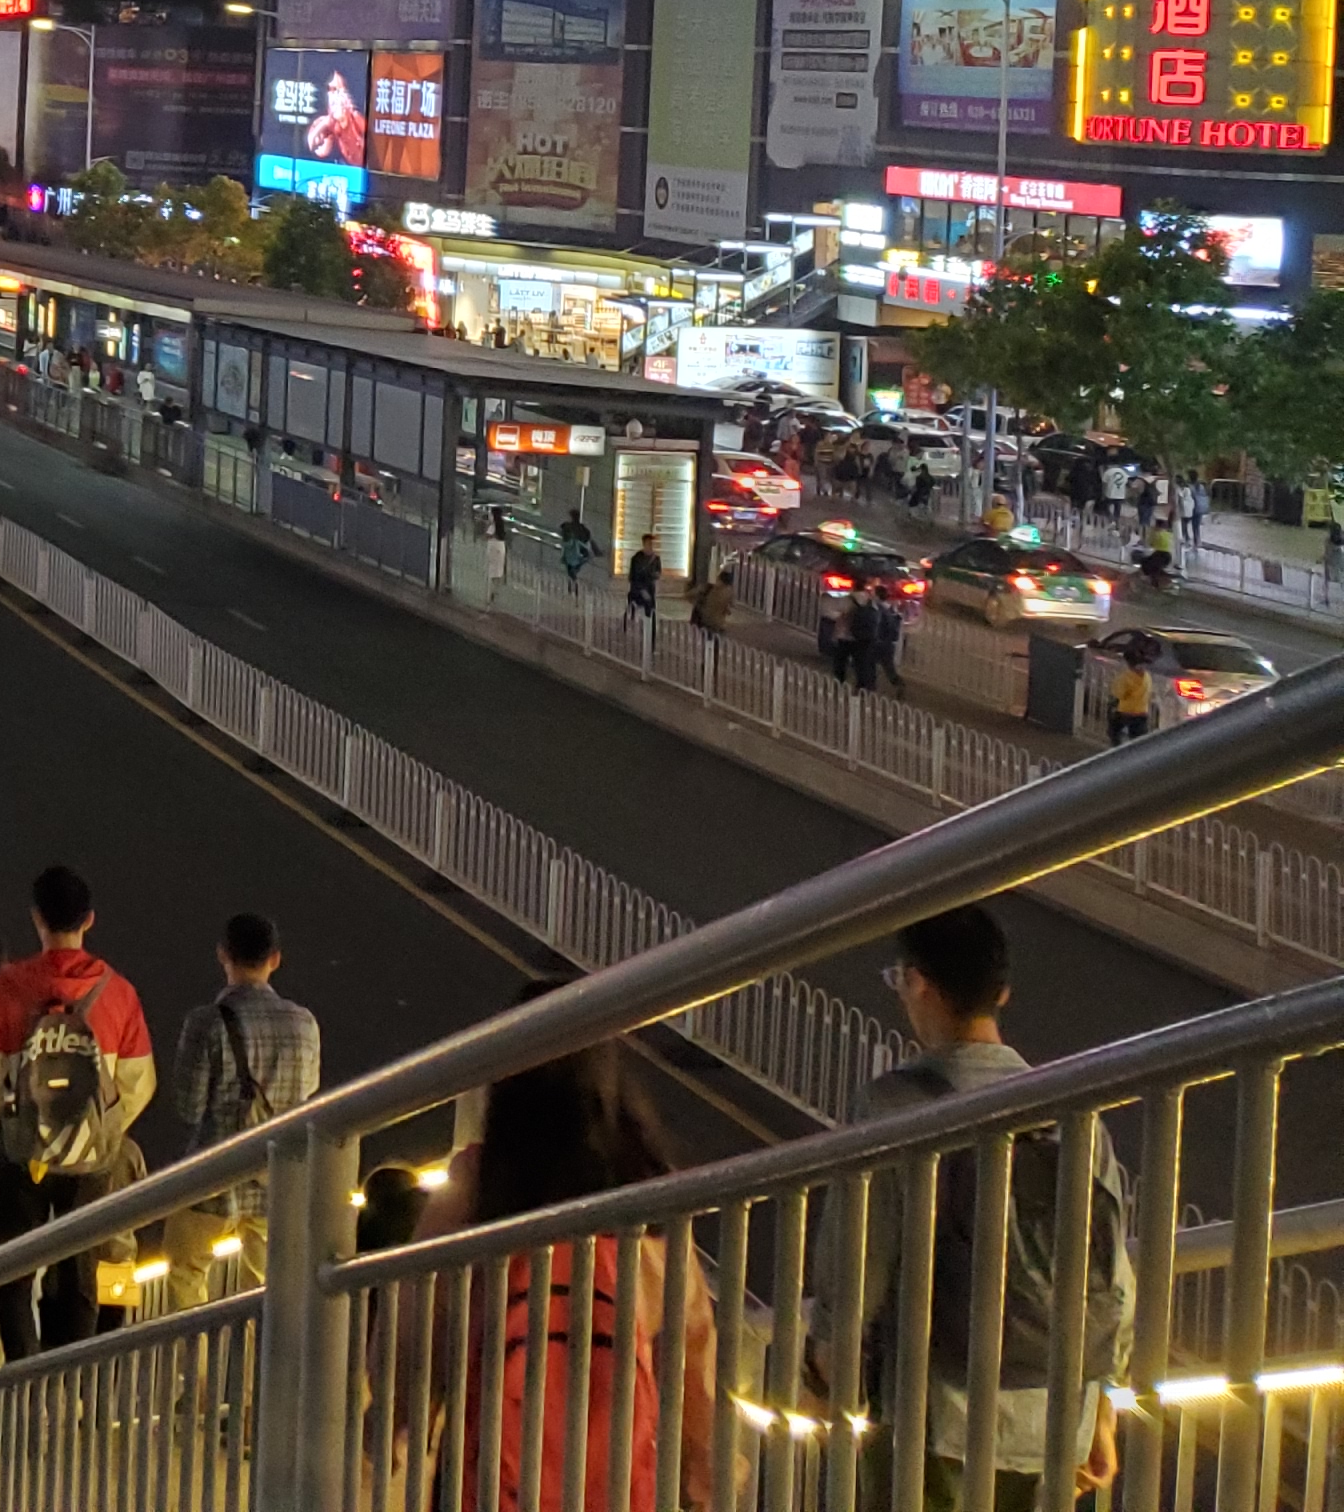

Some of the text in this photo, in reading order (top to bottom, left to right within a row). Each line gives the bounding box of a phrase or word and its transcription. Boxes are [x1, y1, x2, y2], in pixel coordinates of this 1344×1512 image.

[376, 78, 436, 118] 莱福广场
[1201, 119, 1320, 151] HOTEL
